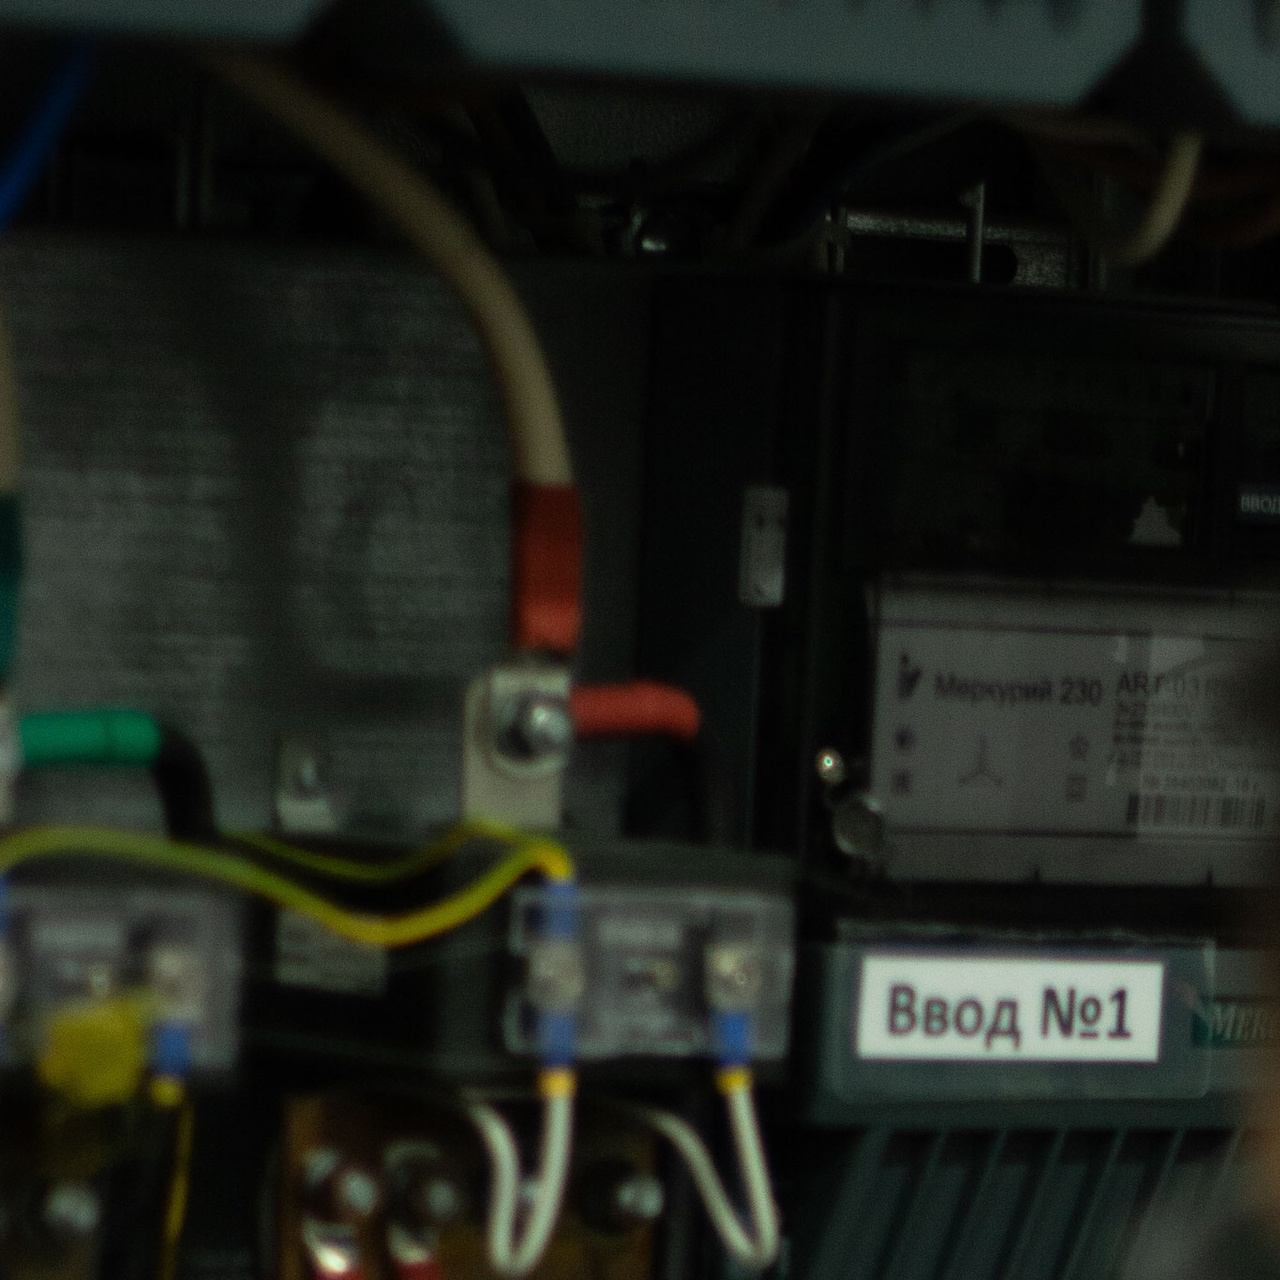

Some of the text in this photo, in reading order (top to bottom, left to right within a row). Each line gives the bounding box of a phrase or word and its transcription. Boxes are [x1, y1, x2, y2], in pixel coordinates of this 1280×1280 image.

[1060, 677, 1102, 706] 230
[888, 984, 1132, 1051] Ввод №1
